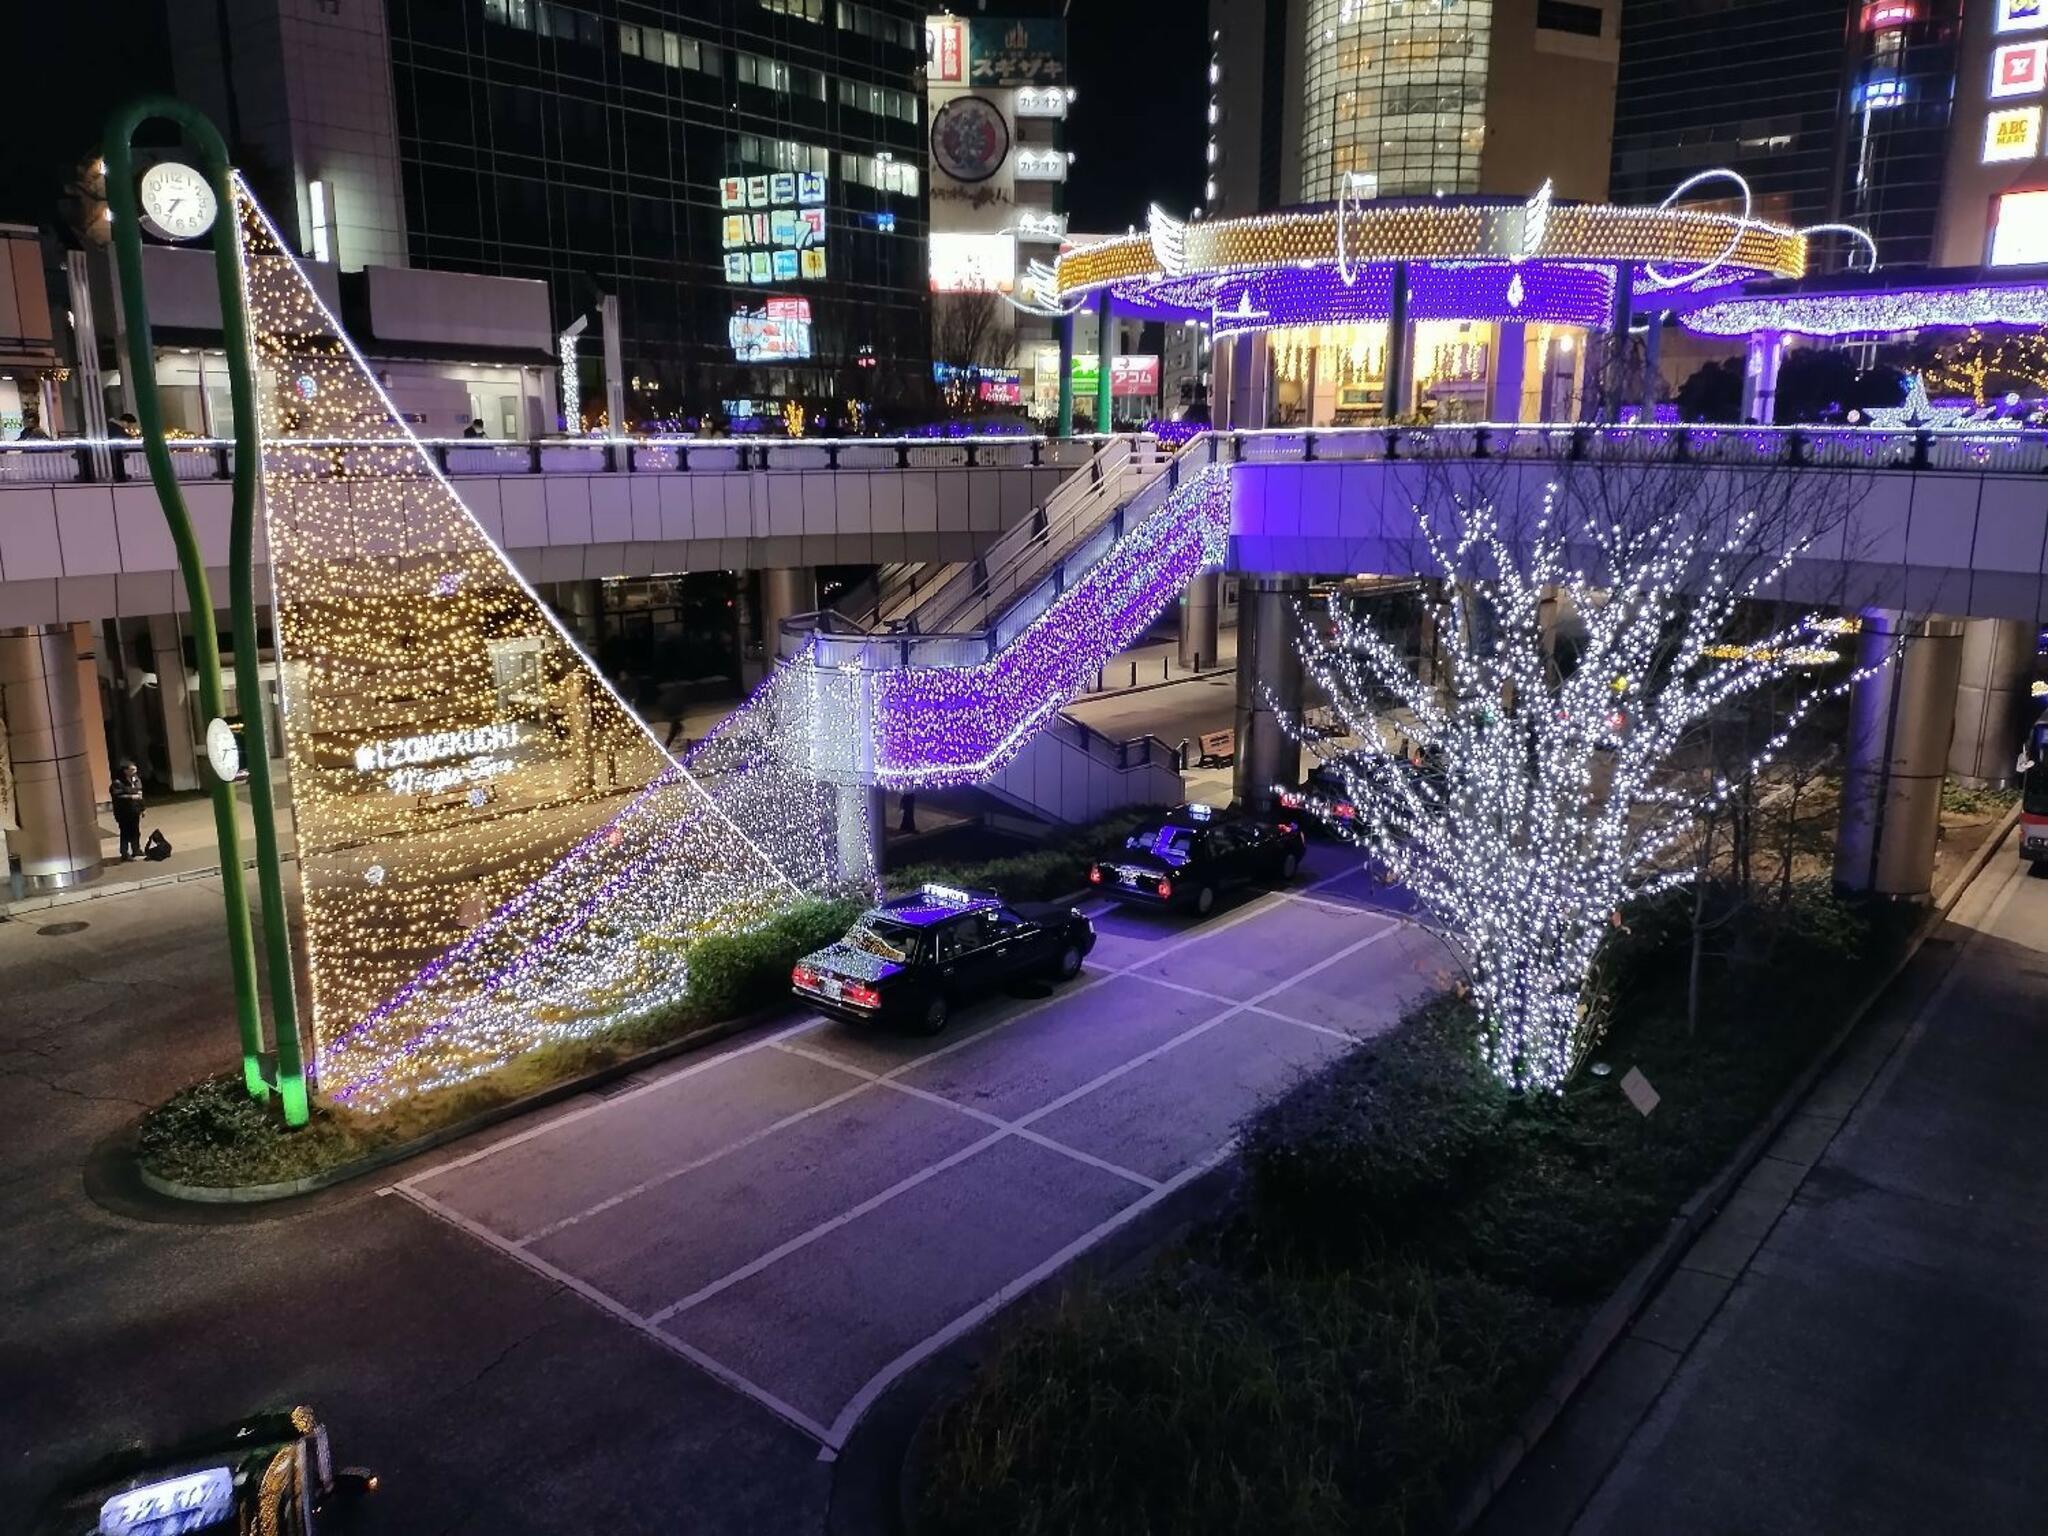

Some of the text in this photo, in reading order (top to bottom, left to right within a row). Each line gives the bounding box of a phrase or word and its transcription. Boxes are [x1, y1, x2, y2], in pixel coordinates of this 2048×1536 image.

[1020, 97, 1060, 108] カラオケ
[1997, 120, 2028, 136] ABC
[1996, 134, 2026, 145] MART
[1020, 161, 1060, 171] カラオケ
[1115, 371, 1152, 384] アコム
[354, 722, 520, 772] IZONOKUCHI
